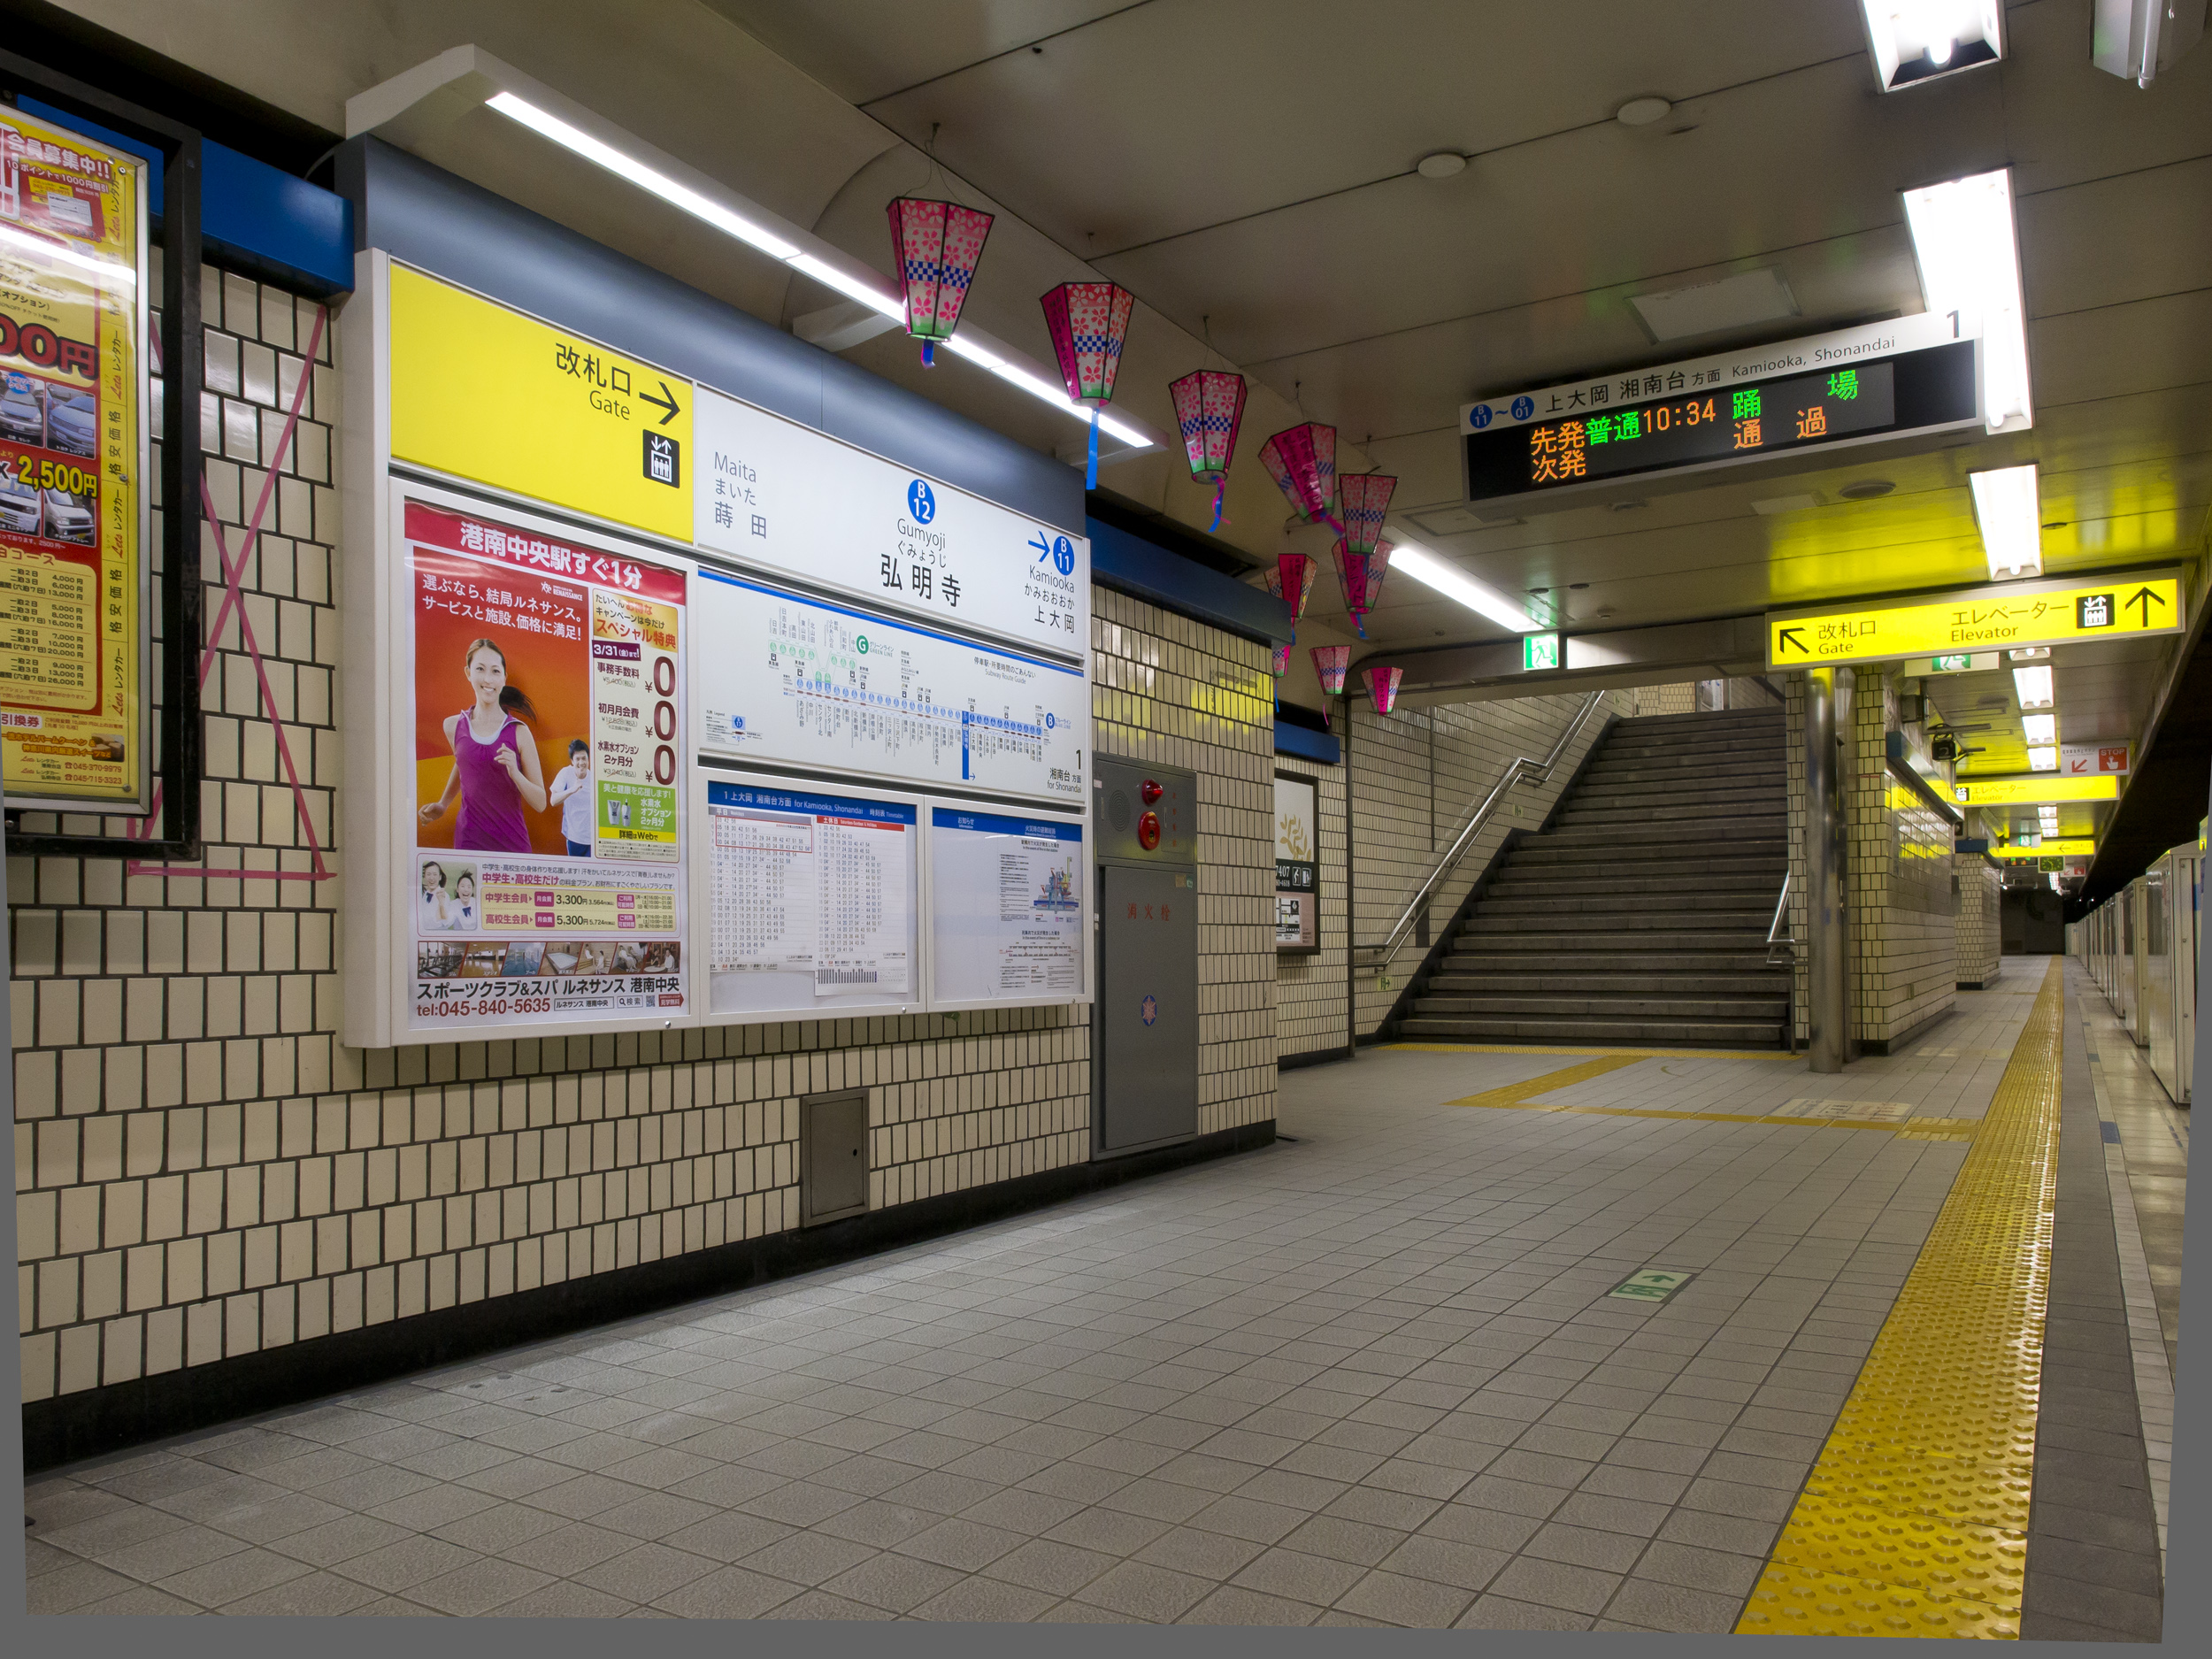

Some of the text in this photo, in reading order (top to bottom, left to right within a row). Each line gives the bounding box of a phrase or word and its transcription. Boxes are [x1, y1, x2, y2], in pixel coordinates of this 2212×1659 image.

[7, 134, 111, 179] 会員募集中!!
[555, 342, 632, 397] 改札口
[1545, 310, 1961, 413] 上大岡 湘南台 方面 Kamiooka, Shonandai 1
[588, 390, 631, 421] Gate
[1478, 405, 1485, 415] B
[1515, 405, 1529, 418] 01
[1519, 396, 1525, 407] B
[1474, 413, 1487, 426] 11
[1643, 398, 1717, 434] 10:34
[714, 451, 757, 483] Maita
[1532, 449, 1586, 483] 次発
[17, 455, 98, 499] 2,500円
[714, 479, 757, 506] まいた
[917, 480, 926, 499] B
[913, 497, 931, 521] 12
[896, 518, 947, 550] Gumyoji
[1060, 536, 1067, 553] B
[459, 520, 643, 590] 港南中央駅すぐ1分
[897, 539, 947, 569] ぐみょうじ
[1057, 552, 1070, 572] 11
[880, 553, 961, 608] 弘明寺
[1029, 565, 1075, 594] Kamiooka
[422, 573, 582, 623] 選ぶなら、結局ルネサンス。
[553, 588, 583, 602] RENAISSANCE
[1025, 583, 1075, 611] かみおおおか
[422, 595, 582, 641] サービスと施設、価格に満足!
[595, 607, 665, 629] キャンペーンは今だけ
[1033, 604, 1075, 634] 上大岡
[1817, 601, 2070, 641] 改札口 エレベーター
[596, 619, 677, 649] スペシャル特典
[858, 638, 866, 651] G
[1818, 625, 2019, 656] Gate Elevator
[869, 641, 895, 652] グリーンライン
[597, 662, 640, 680] 事務手数料
[985, 668, 1026, 685] Subway Route Guide
[598, 703, 640, 719] 初月月会費
[597, 741, 640, 756] 水素水オプション
[2101, 748, 2125, 757] STOP
[1075, 749, 1081, 770] 1
[1049, 766, 1082, 784] 湘南台 方面
[1047, 780, 1082, 793] for Shonandai
[1972, 783, 2026, 795] エレベーター
[641, 797, 661, 808] 水素水
[641, 808, 672, 818] オプション
[730, 791, 753, 803] 上大岡
[756, 794, 792, 807] 湘南台方面
[794, 799, 803, 808] for
[803, 801, 833, 812] Kamiooka,
[833, 804, 864, 815] Shonandai
[957, 817, 975, 826] お知らせ
[485, 892, 528, 904] 中学生会員
[485, 914, 529, 925] 高校生会員
[417, 977, 680, 1000] スポーツクラブ&スパ ルネサンス 港南中央
[417, 997, 550, 1018] tel:045-840-5635
[626, 997, 641, 1006] 検索
